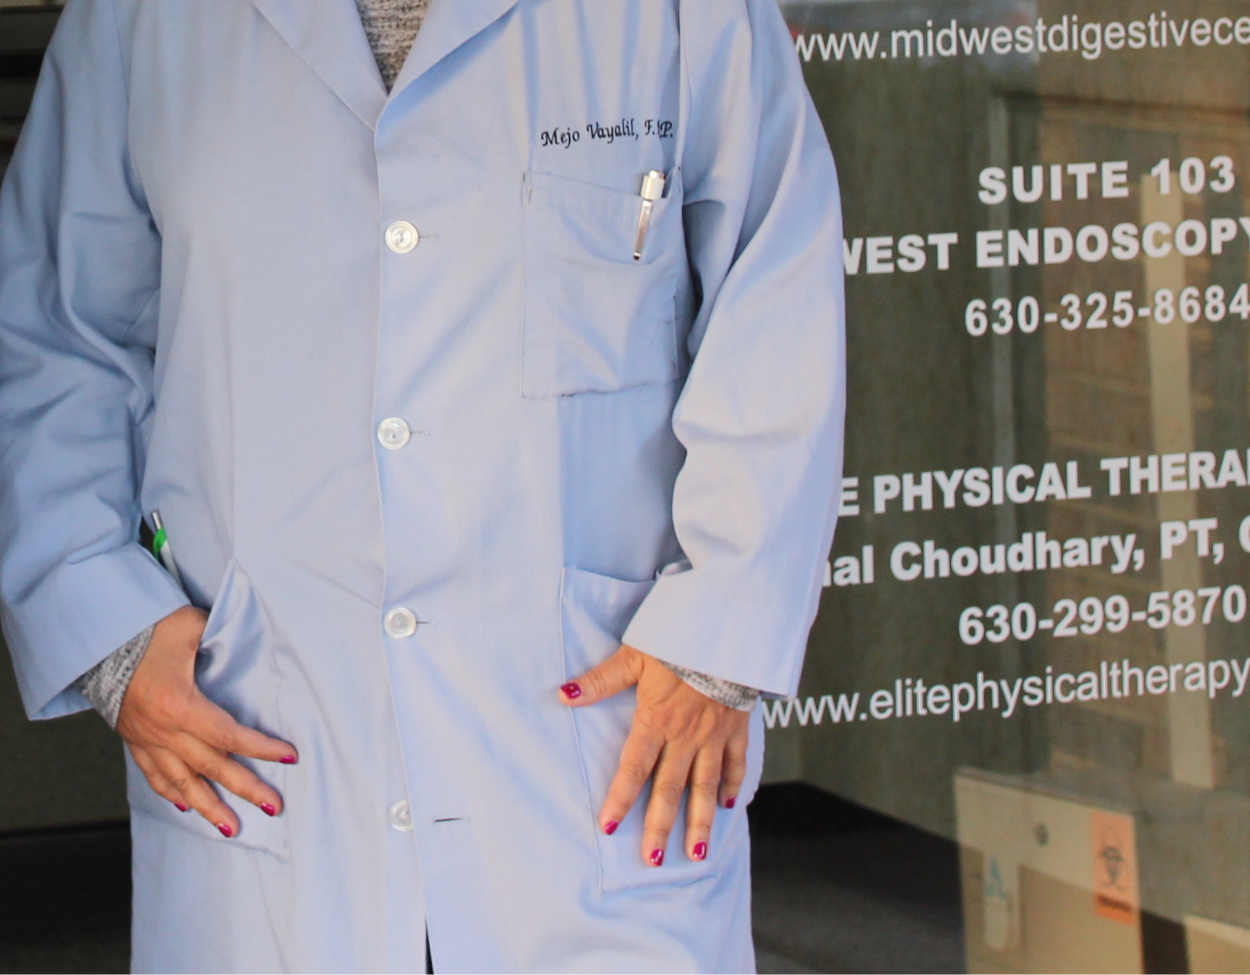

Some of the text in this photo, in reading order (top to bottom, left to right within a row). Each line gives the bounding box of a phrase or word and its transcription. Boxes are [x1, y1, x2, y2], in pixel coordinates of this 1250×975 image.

[540, 127, 581, 149] Mejo
[586, 117, 640, 144] Vayalil,
[979, 156, 1236, 205] SUITE 103
[965, 283, 1250, 336] 630-325-8684
[874, 461, 1091, 514] PHYSICAL
[1101, 449, 1250, 496] THERA
[891, 530, 1144, 582] Choudhary,
[1161, 518, 1224, 564] PT,
[960, 585, 1247, 645] 630-299-5870
[762, 657, 1250, 729] www.elitephysicaltherapy
